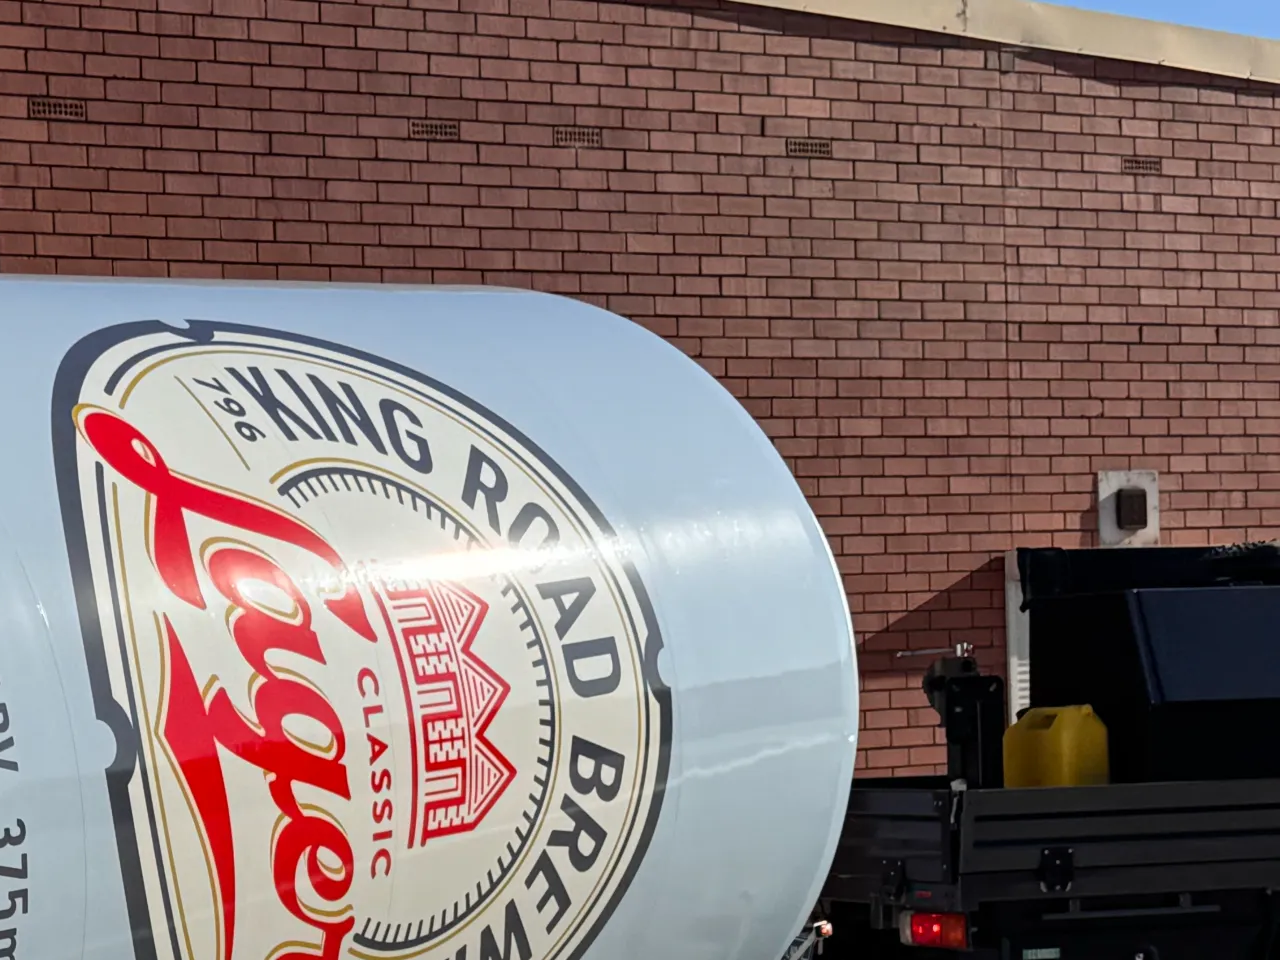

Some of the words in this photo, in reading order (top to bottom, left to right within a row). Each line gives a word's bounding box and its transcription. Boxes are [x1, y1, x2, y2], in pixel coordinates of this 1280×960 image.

[223, 365, 435, 475] KING
[461, 444, 624, 700] ROAD
[356, 665, 393, 880] CLASSIC
